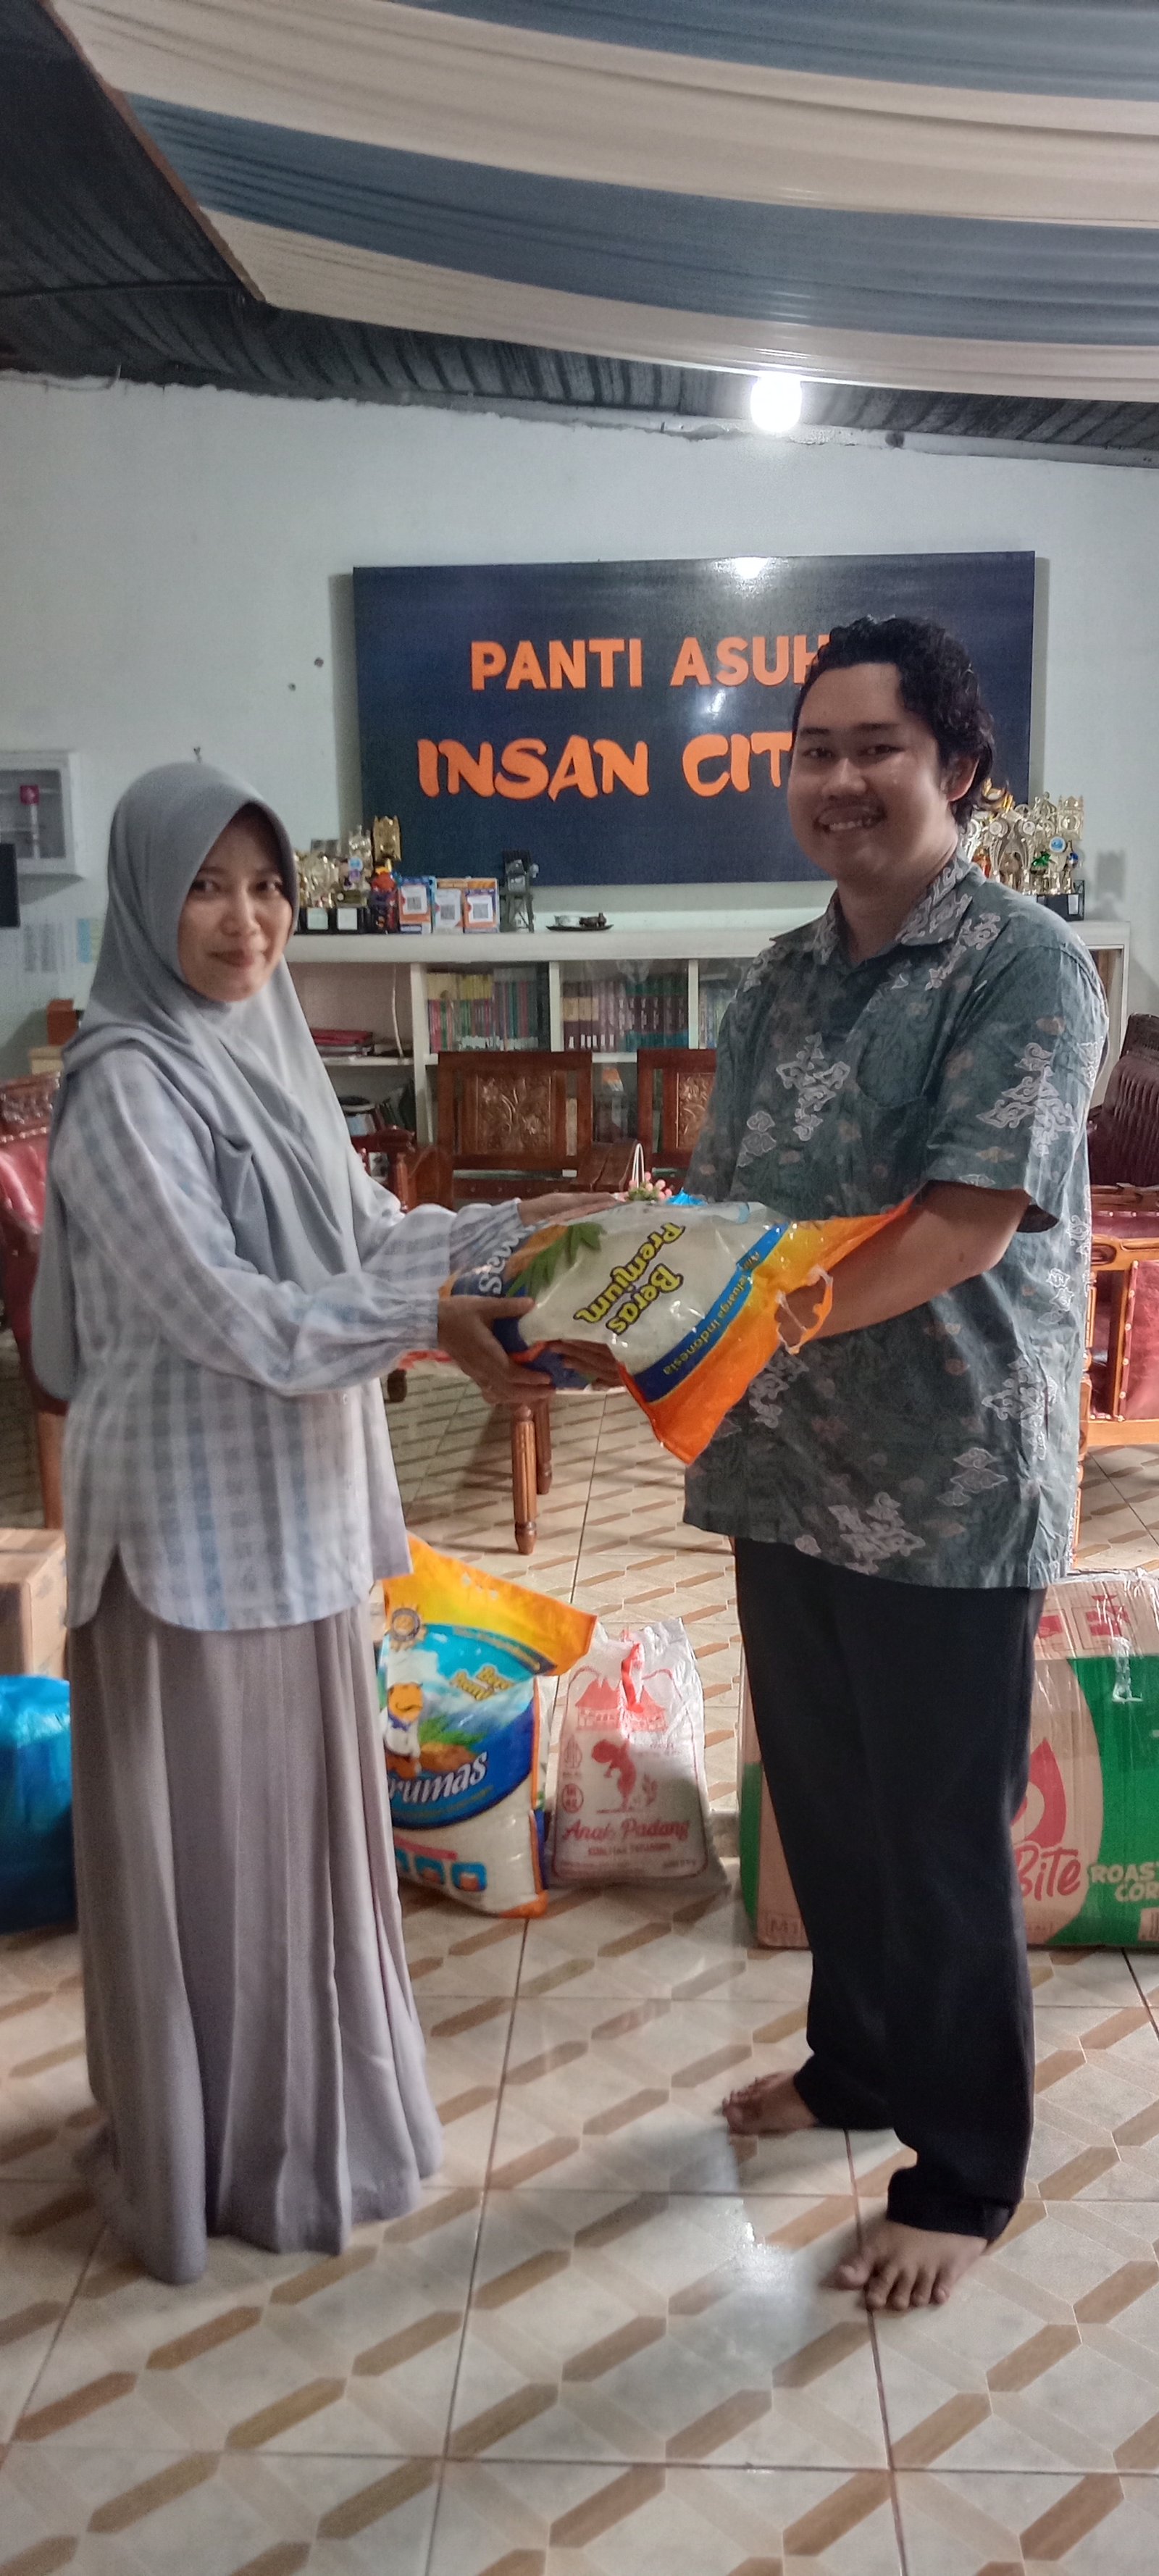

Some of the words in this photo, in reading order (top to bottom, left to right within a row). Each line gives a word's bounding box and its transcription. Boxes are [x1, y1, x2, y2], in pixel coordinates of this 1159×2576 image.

[471, 638, 643, 690] PANTI
[671, 634, 830, 687] ASUH
[417, 733, 650, 802] INSAN
[683, 731, 794, 798] CIT
[572, 1222, 686, 1323] Premium
[605, 1263, 684, 1336] Beras
[388, 1751, 488, 1804] rumas
[1089, 1861, 1159, 1883] ROAS
